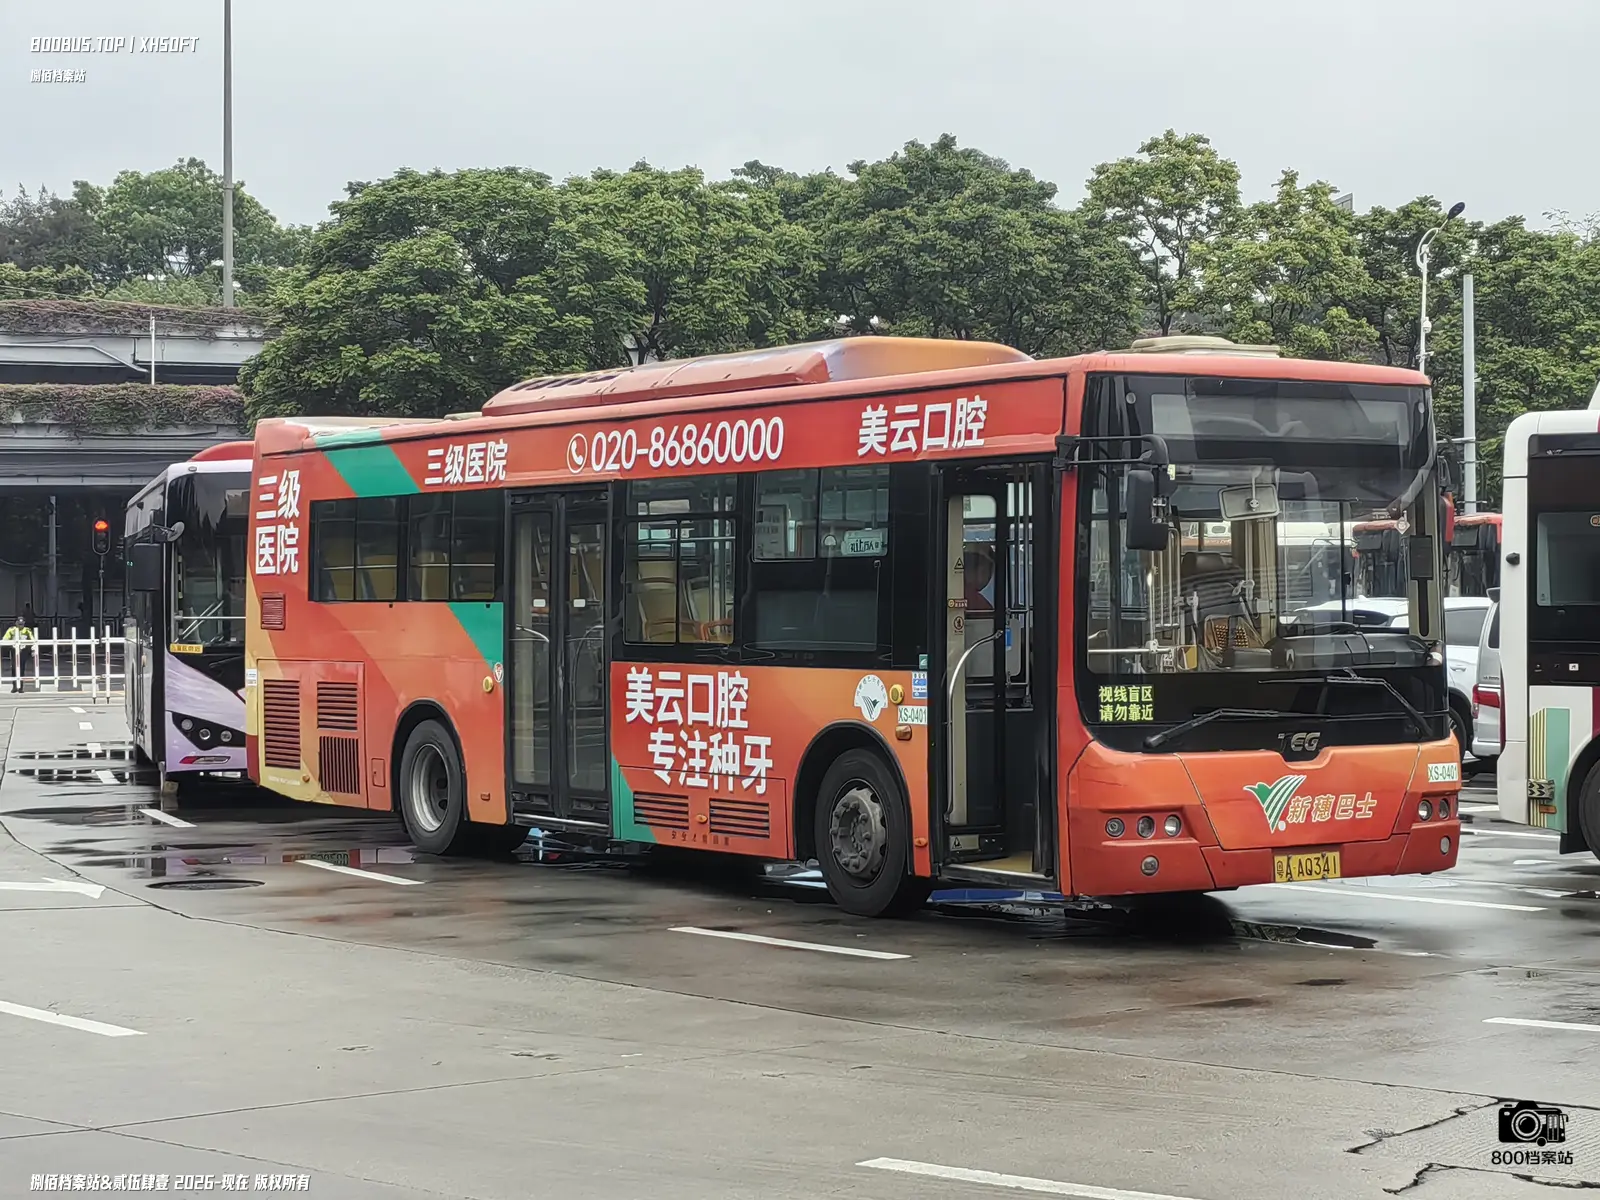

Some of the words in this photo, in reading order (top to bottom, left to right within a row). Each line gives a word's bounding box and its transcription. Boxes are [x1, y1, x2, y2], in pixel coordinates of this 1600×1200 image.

[590, 416, 784, 472] 020-86860000
[858, 396, 988, 456] 美云口腔
[424, 438, 508, 485] 三级医院
[256, 469, 301, 519] 三级
[255, 521, 299, 575] 医院
[625, 666, 749, 729] 美云口腔
[898, 707, 927, 723] XS-0401
[1098, 685, 1154, 703] 视线盲区
[1099, 703, 1154, 721] 请勿靠近
[647, 727, 773, 795] 专注种牙
[1428, 764, 1458, 782] XS-0401
[1287, 792, 1377, 824] 新穗巴士
